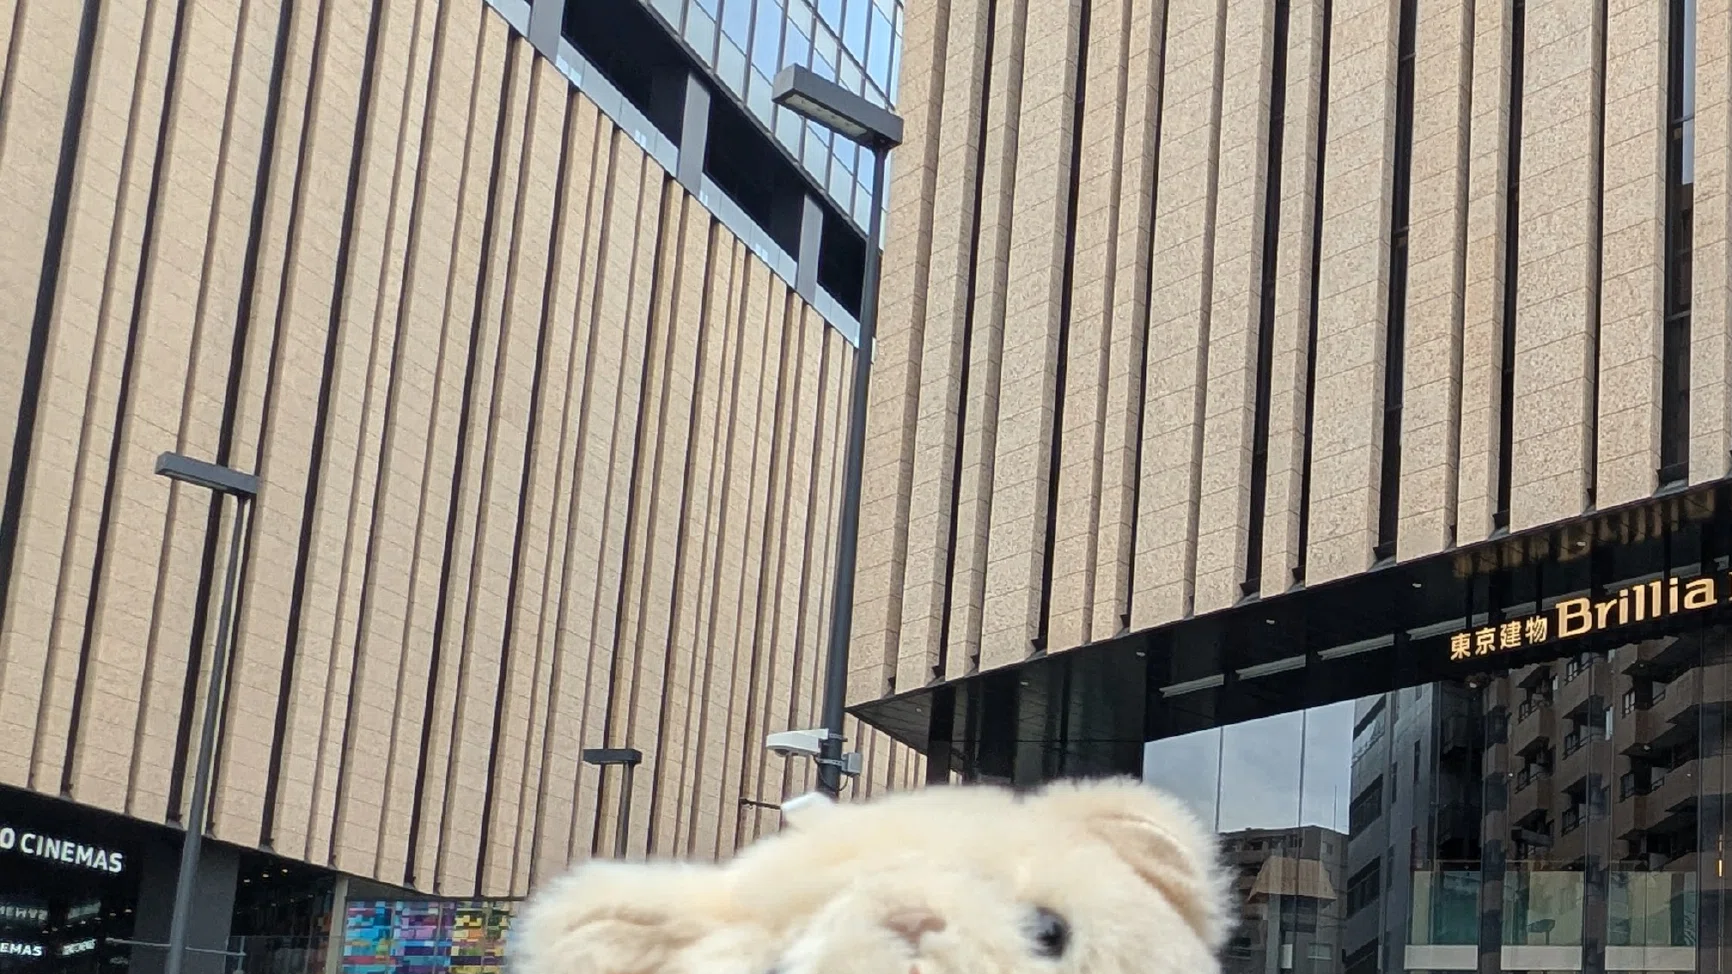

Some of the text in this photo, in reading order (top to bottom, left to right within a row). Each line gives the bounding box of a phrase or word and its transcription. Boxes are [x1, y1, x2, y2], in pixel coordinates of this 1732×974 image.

[1449, 615, 1548, 661] 東京建物
[1556, 575, 1718, 639] Brillia
[20, 833, 123, 873] CINEMAS
